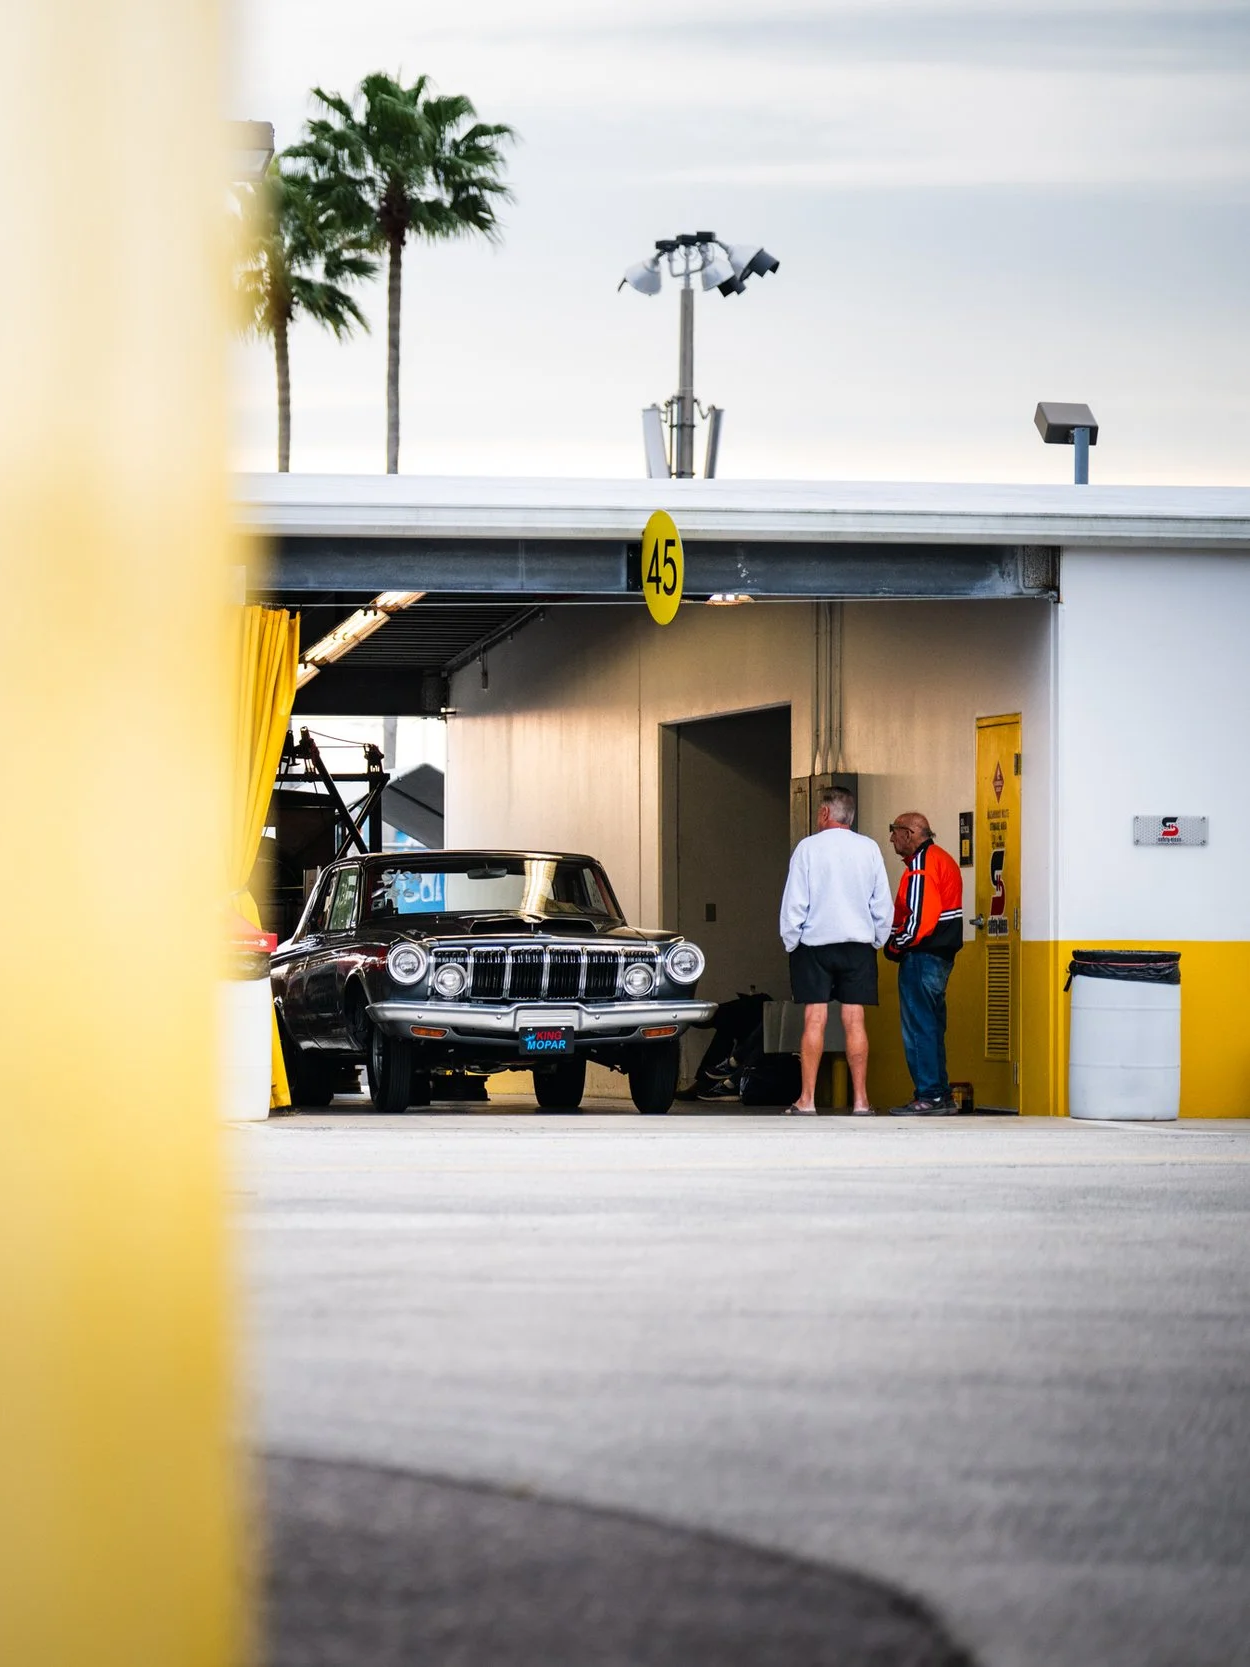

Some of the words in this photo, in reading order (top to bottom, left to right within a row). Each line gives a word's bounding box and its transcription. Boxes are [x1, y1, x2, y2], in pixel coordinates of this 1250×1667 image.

[647, 538, 677, 596] 45
[536, 1031, 562, 1040] KING
[527, 1040, 566, 1050] MOPAR
